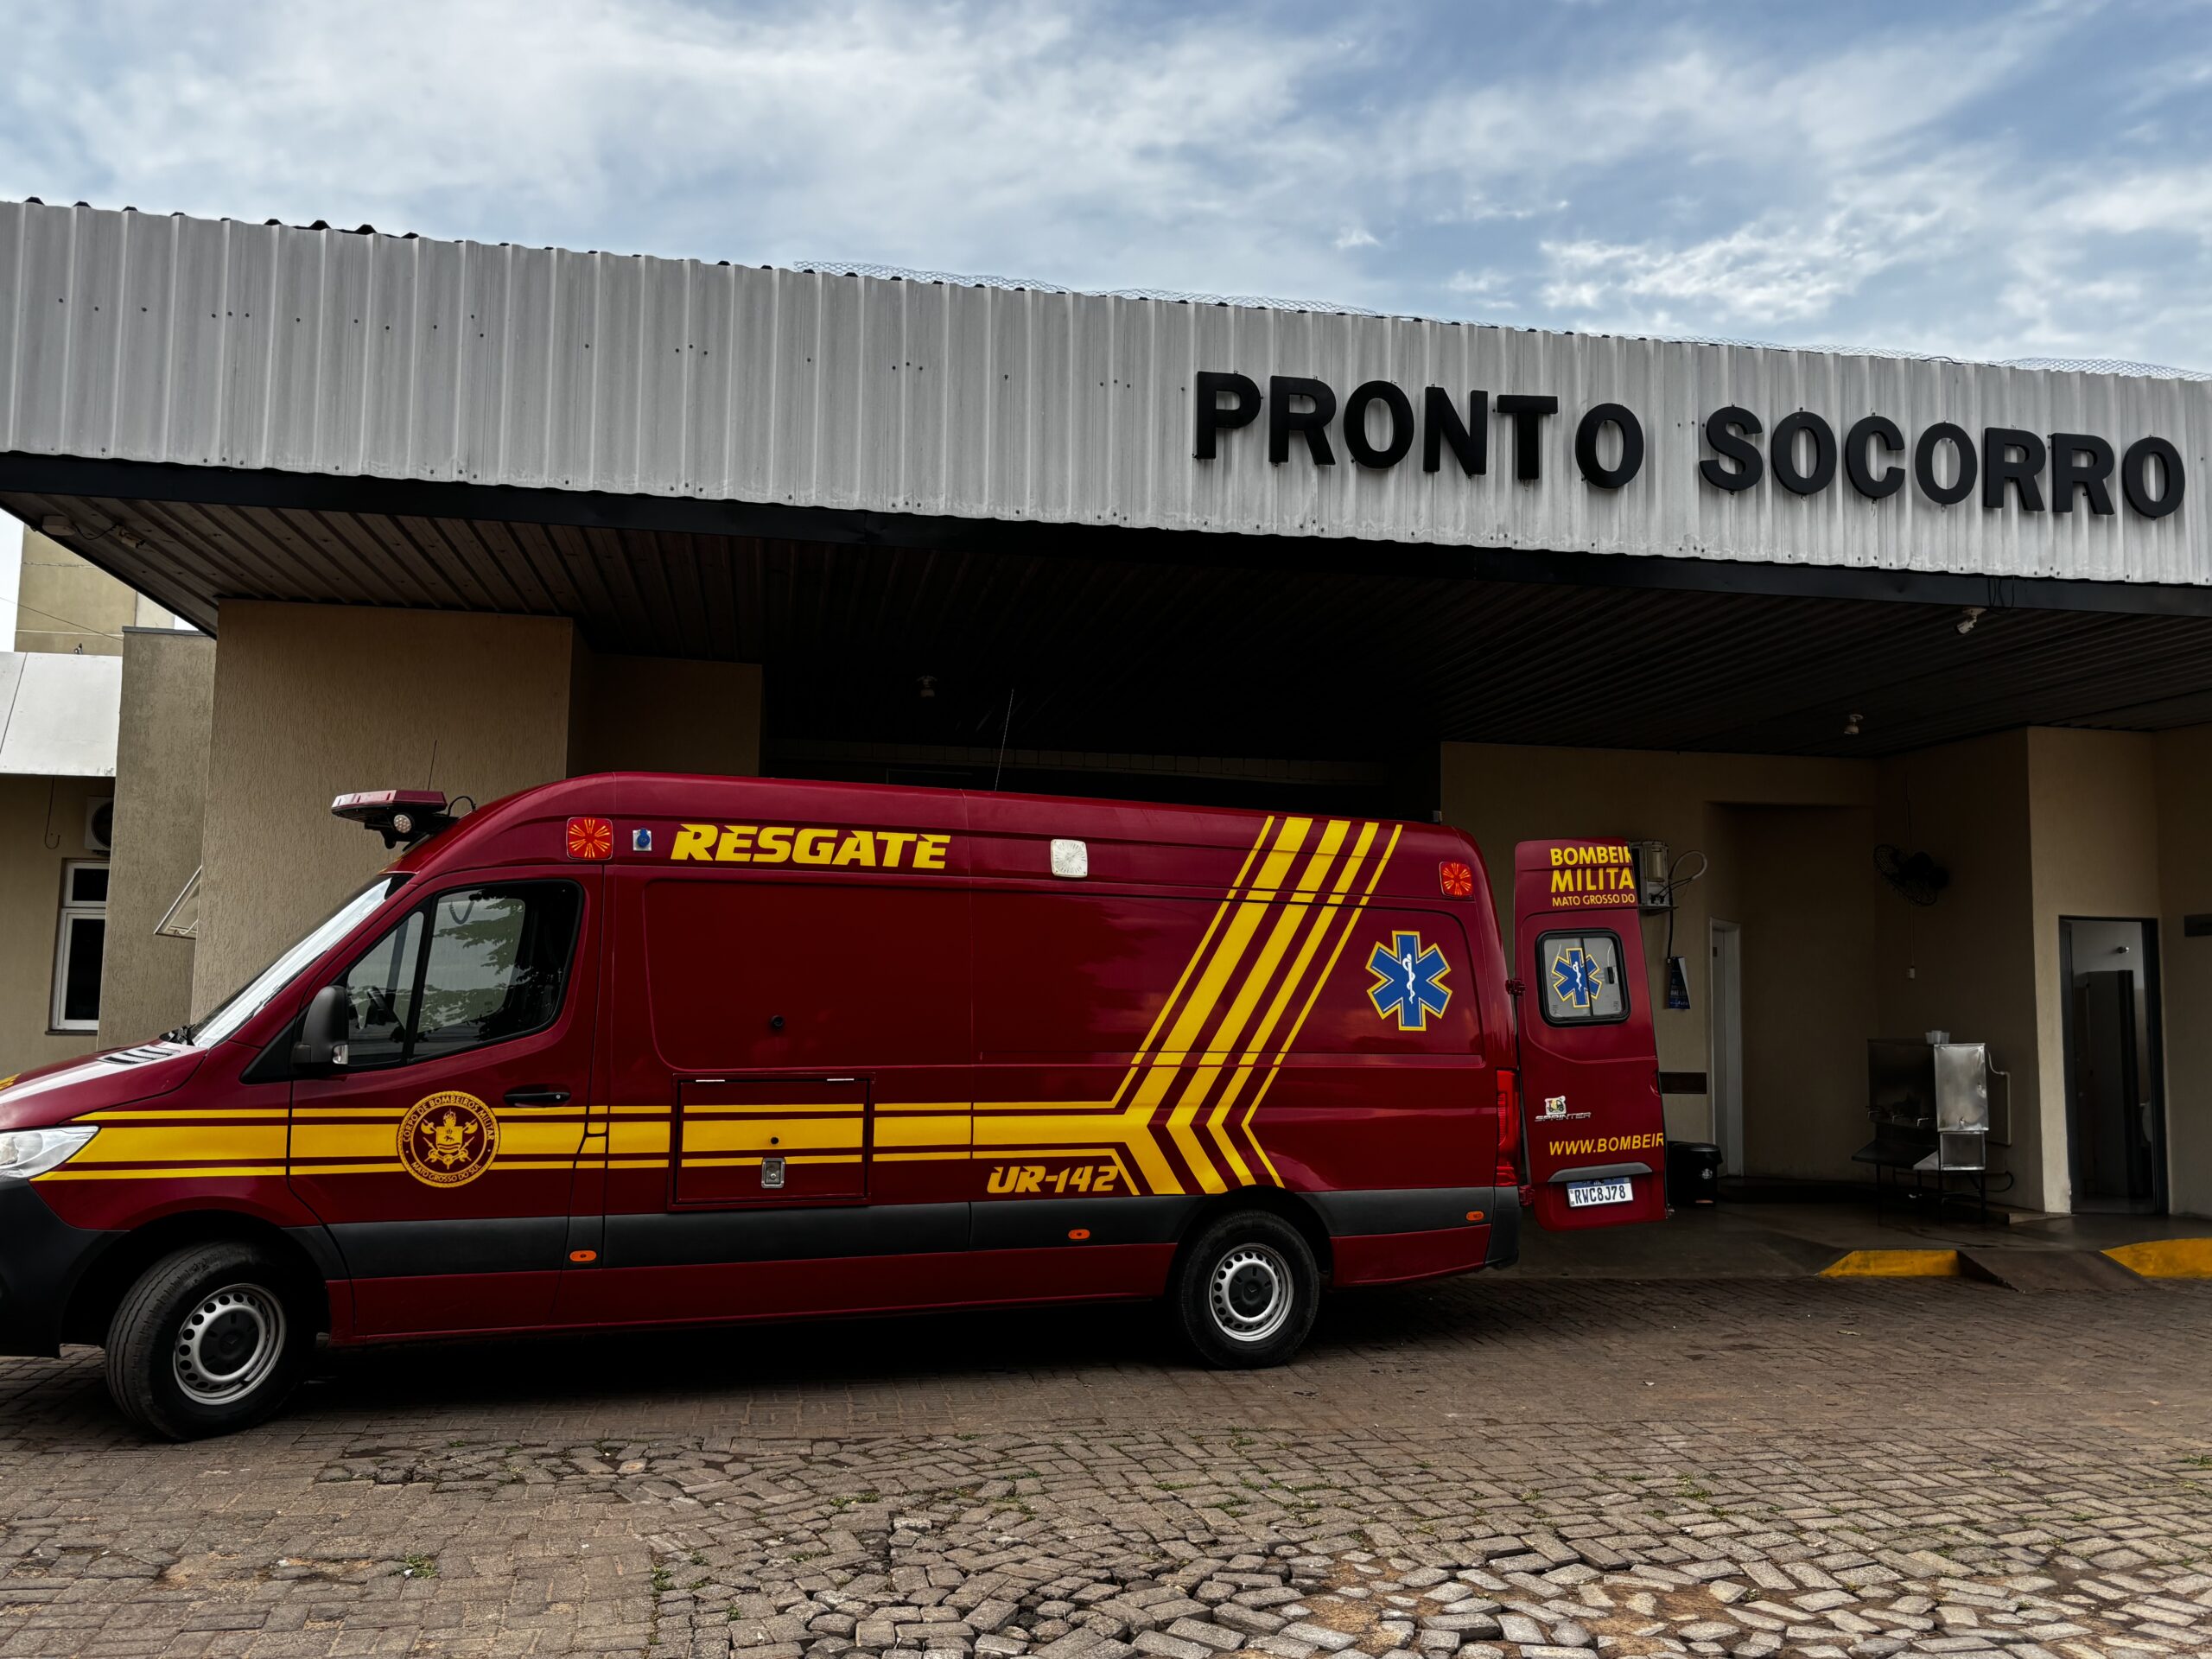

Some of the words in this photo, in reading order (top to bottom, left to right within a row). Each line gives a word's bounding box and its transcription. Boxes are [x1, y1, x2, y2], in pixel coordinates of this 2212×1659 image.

[1195, 370, 1645, 490] PRONTO
[1699, 404, 2187, 518] SOCORRO
[670, 823, 951, 869] RESGATE
[1550, 867, 1636, 893] MILITA
[1552, 895, 1580, 907] MATO
[1582, 893, 1620, 906] GROSSO
[1621, 893, 1636, 904] DO
[404, 1115, 418, 1142] CORPO
[417, 1103, 429, 1115] DE
[429, 1096, 480, 1111] BOMBEIROS
[478, 1109, 495, 1141] MILITAR
[1535, 1111, 1592, 1122] SPRINTER
[411, 1161, 429, 1178] MATO
[429, 1173, 458, 1183] GROSSO
[458, 1171, 469, 1180] DO
[468, 1163, 482, 1176] SUL
[987, 1166, 1119, 1194] UR-142
[1574, 1185, 1626, 1205] RWC8J78
